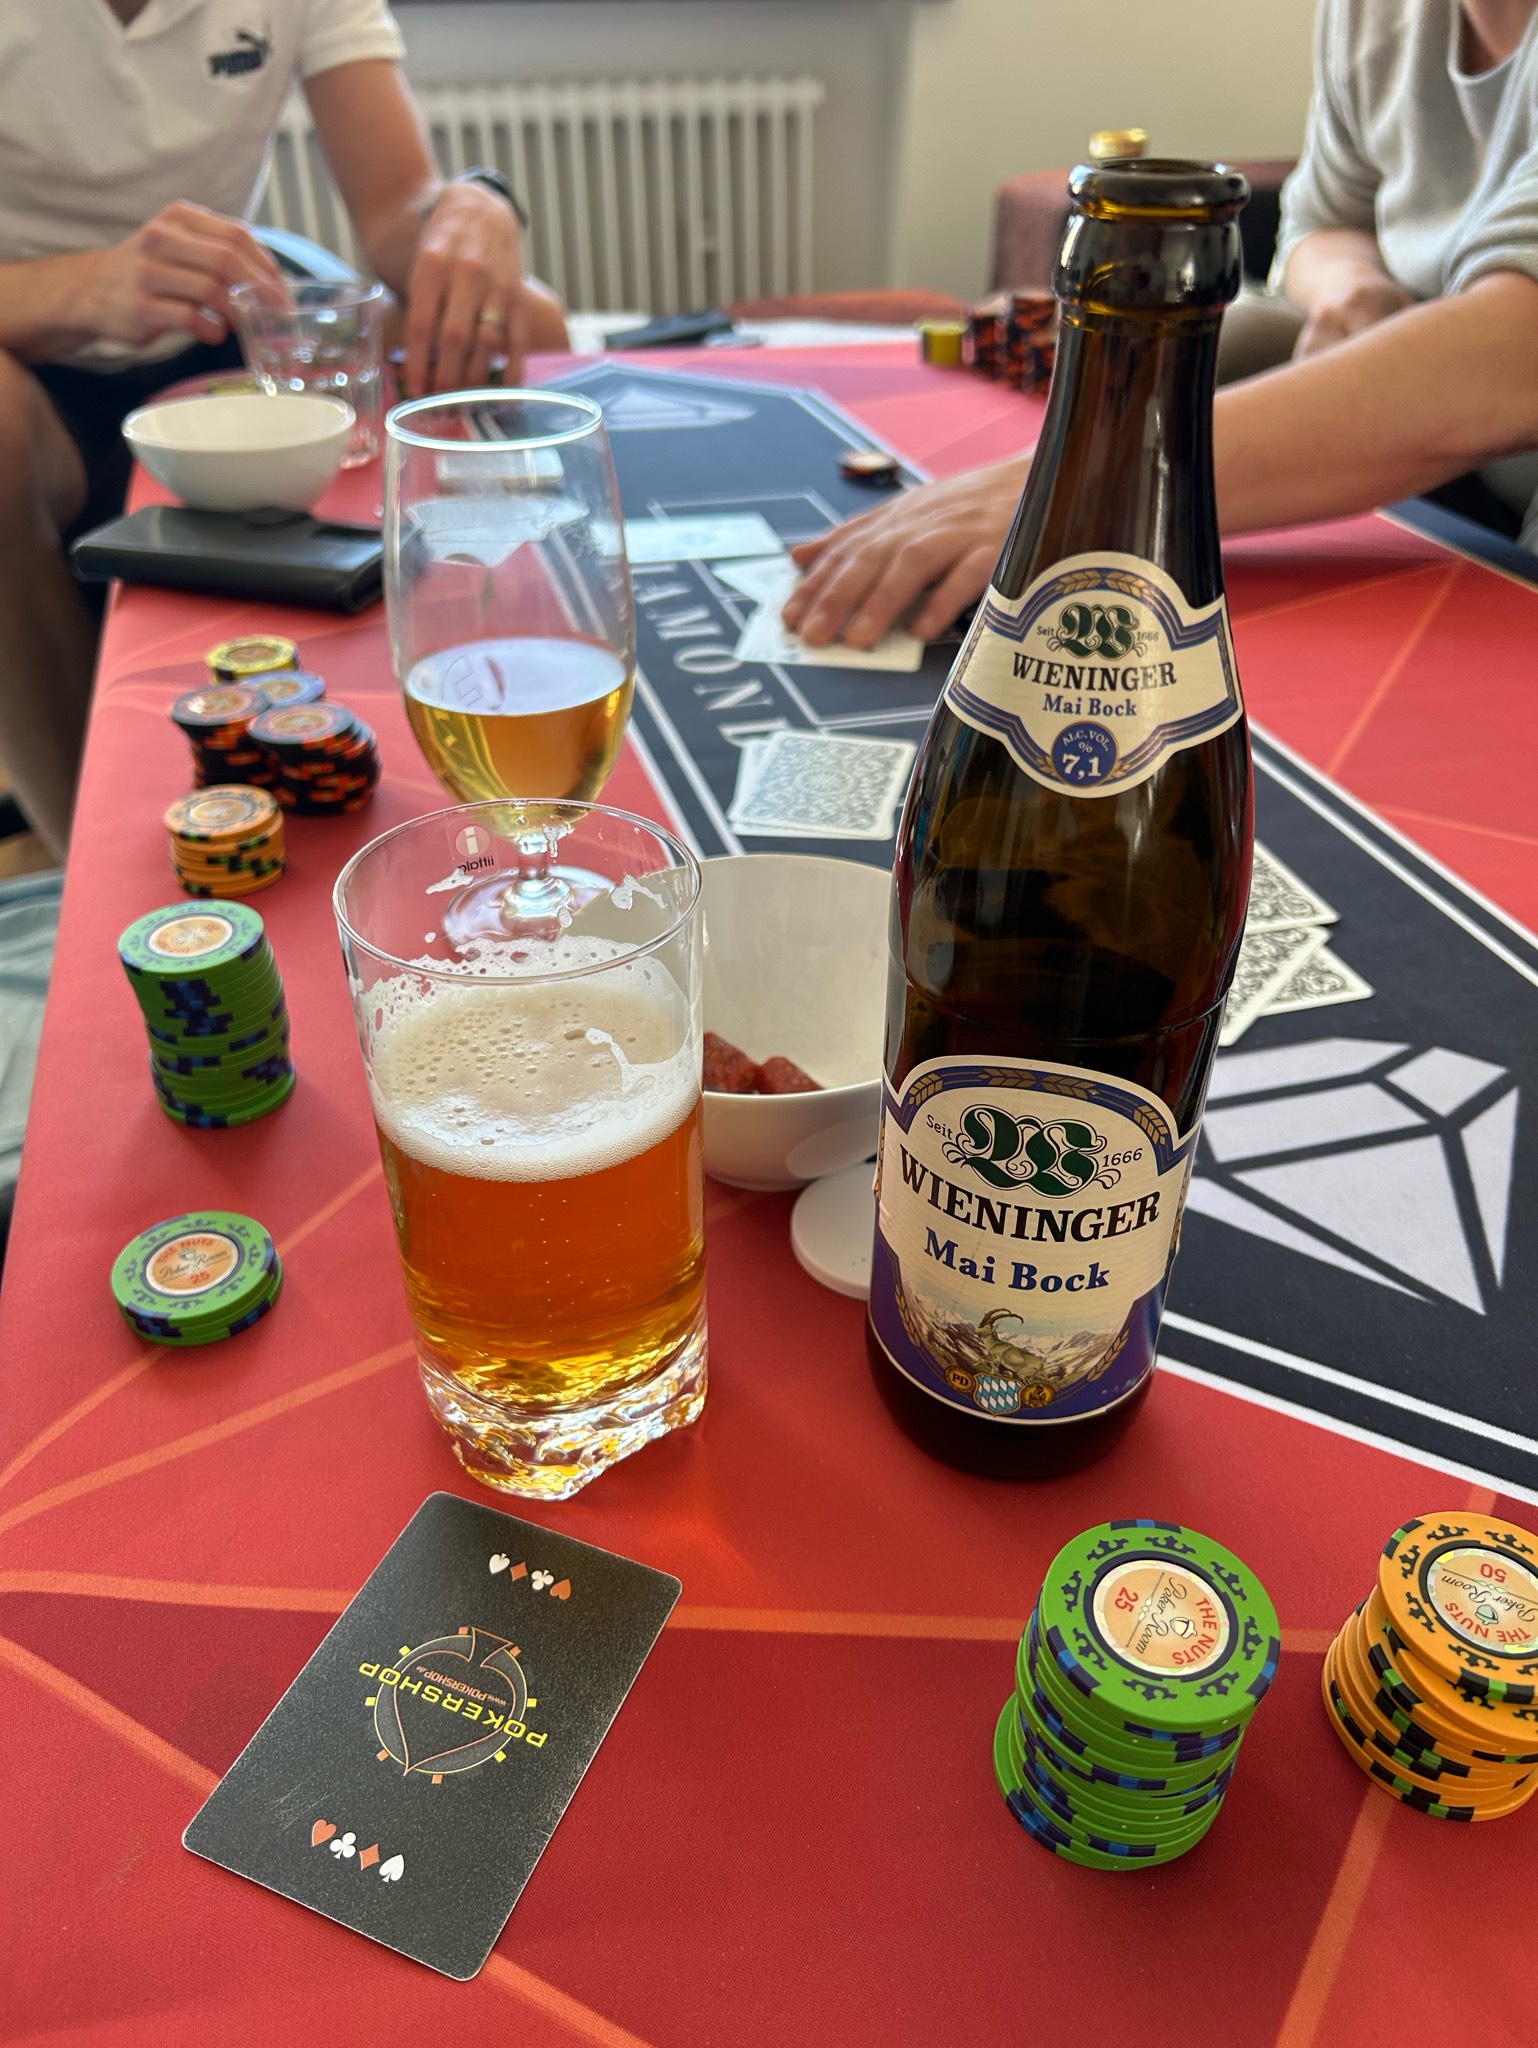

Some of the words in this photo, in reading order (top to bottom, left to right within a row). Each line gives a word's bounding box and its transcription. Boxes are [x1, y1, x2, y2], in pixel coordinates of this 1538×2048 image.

[1037, 626, 1054, 637] Seit
[1137, 632, 1159, 642] 1666
[1012, 652, 1177, 691] WIENINGER
[1042, 693, 1082, 715] Mai
[1088, 698, 1137, 717] Bock
[1078, 742, 1093, 754] %
[1062, 754, 1101, 780] 7,1
[926, 1114, 953, 1140] Seit
[1102, 1147, 1143, 1168] 1666
[900, 1143, 1161, 1243] WIENINGER
[180, 1237, 215, 1248] NUTS
[924, 1227, 996, 1284] Mai
[1008, 1262, 1110, 1293] Bock
[189, 1271, 210, 1285] 25
[952, 1373, 969, 1386] PD
[1480, 1563, 1507, 1584] 50
[1114, 1586, 1139, 1613] 25
[1156, 1577, 1187, 1615] Poker
[1441, 1575, 1492, 1603] Room
[1196, 1597, 1218, 1630] THE
[1444, 1602, 1489, 1639] NUTS
[1493, 1596, 1538, 1622] Poker
[1136, 1612, 1169, 1654] Room
[1496, 1627, 1531, 1643] THE
[1172, 1633, 1215, 1665] NUTS
[359, 1662, 548, 1748] POKERSHOP
